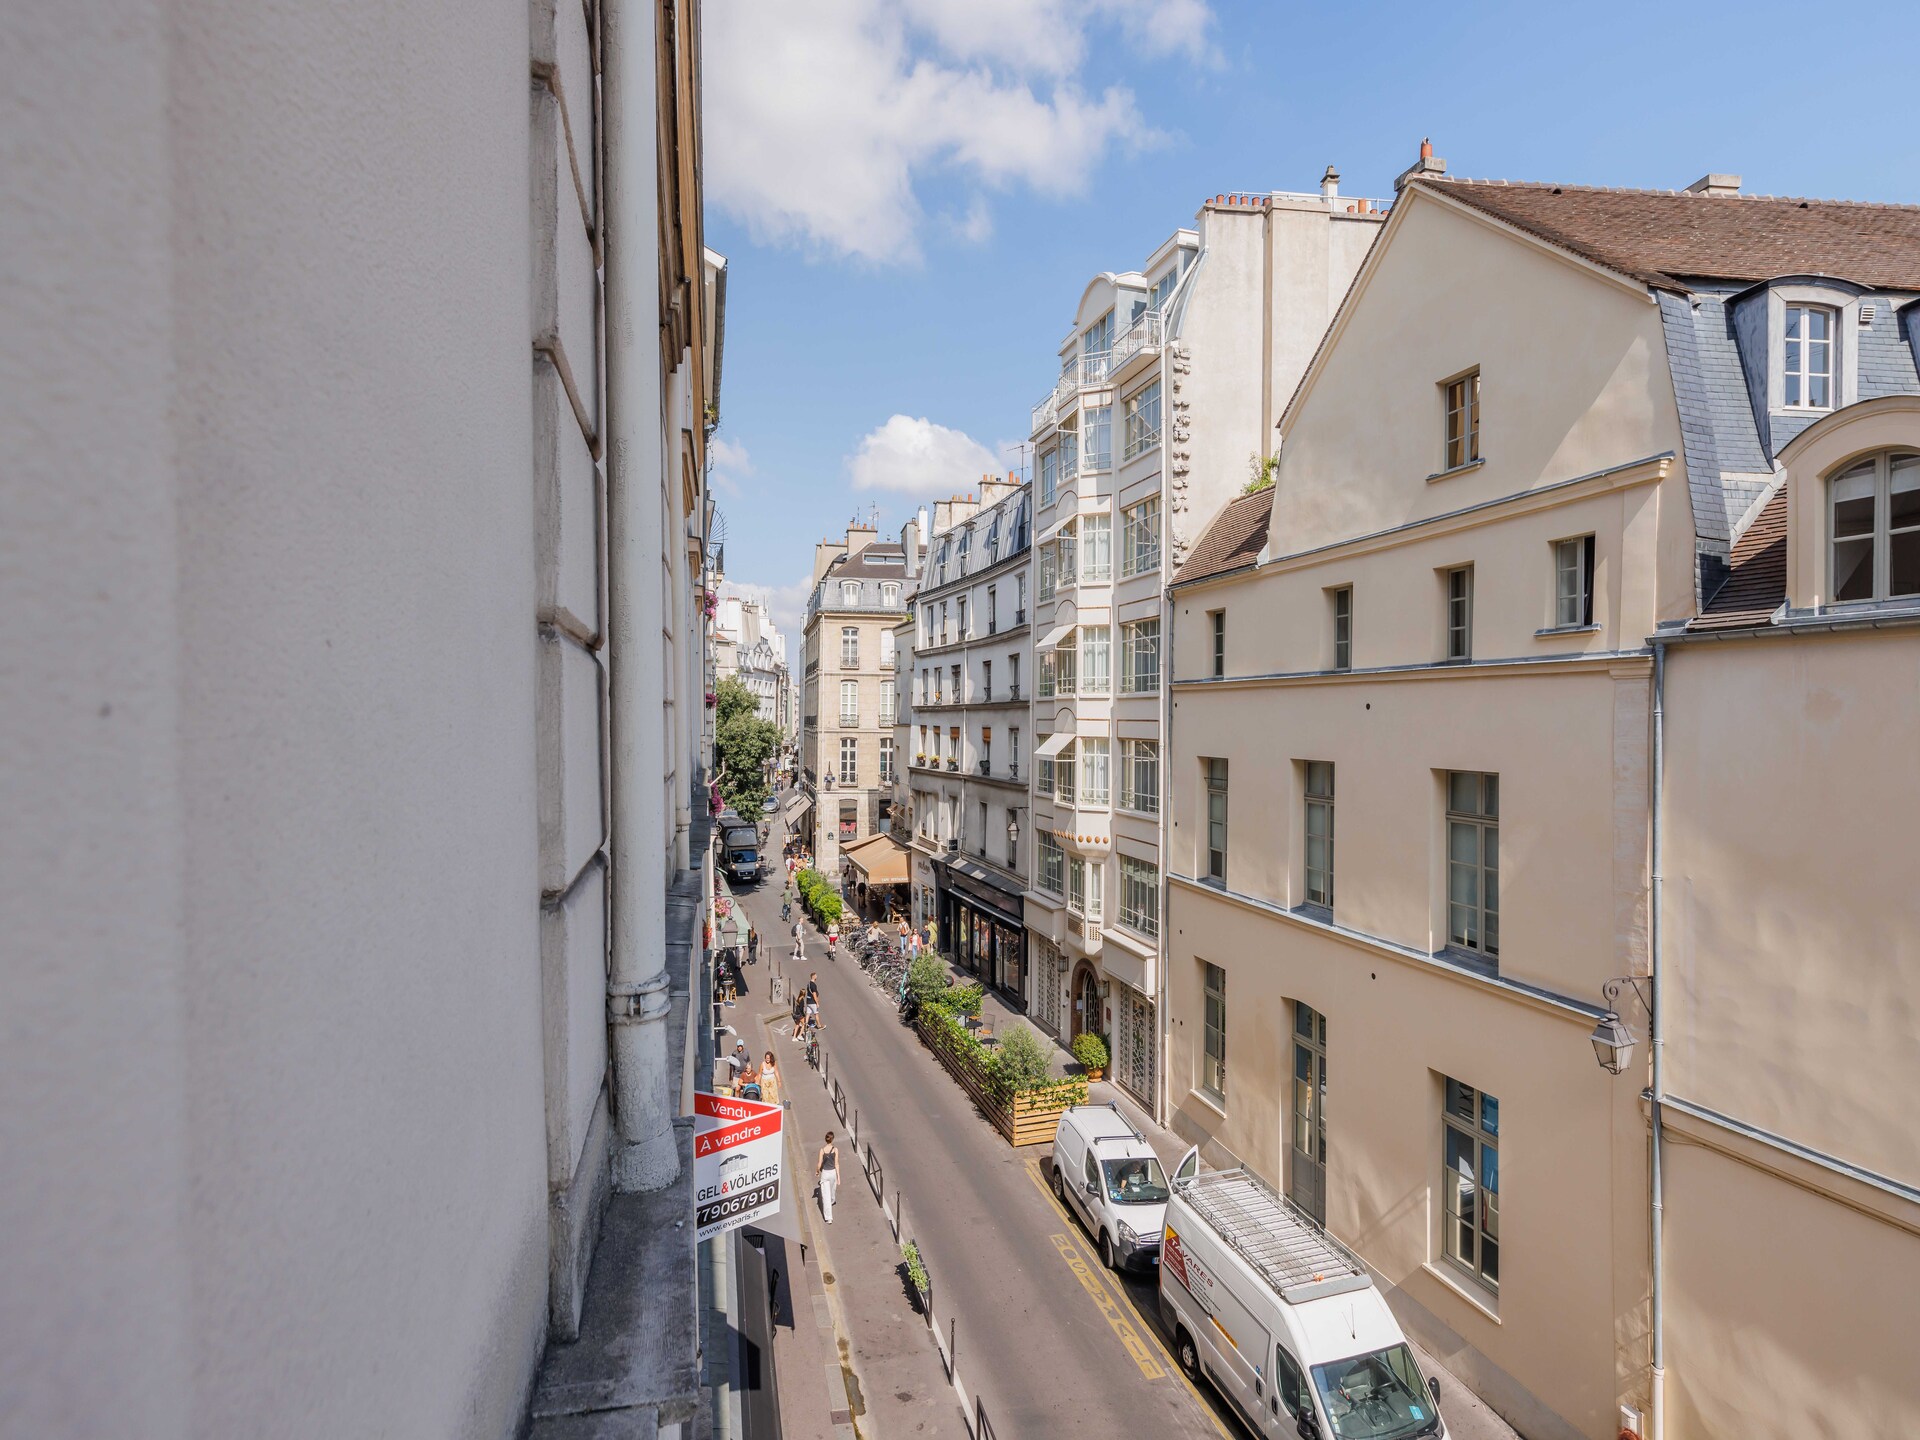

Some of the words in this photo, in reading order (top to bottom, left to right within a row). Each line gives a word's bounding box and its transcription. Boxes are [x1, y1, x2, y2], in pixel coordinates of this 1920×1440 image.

[710, 1101, 752, 1118] Vendu
[700, 1136, 711, 1153] À
[715, 1126, 761, 1147] vendre
[697, 1164, 778, 1201] GEL&VÖLKERS
[699, 1210, 760, 1238] www.evparis.fr
[1171, 1237, 1214, 1288] TAVARES
[1054, 1236, 1161, 1376] LIVRAISON
